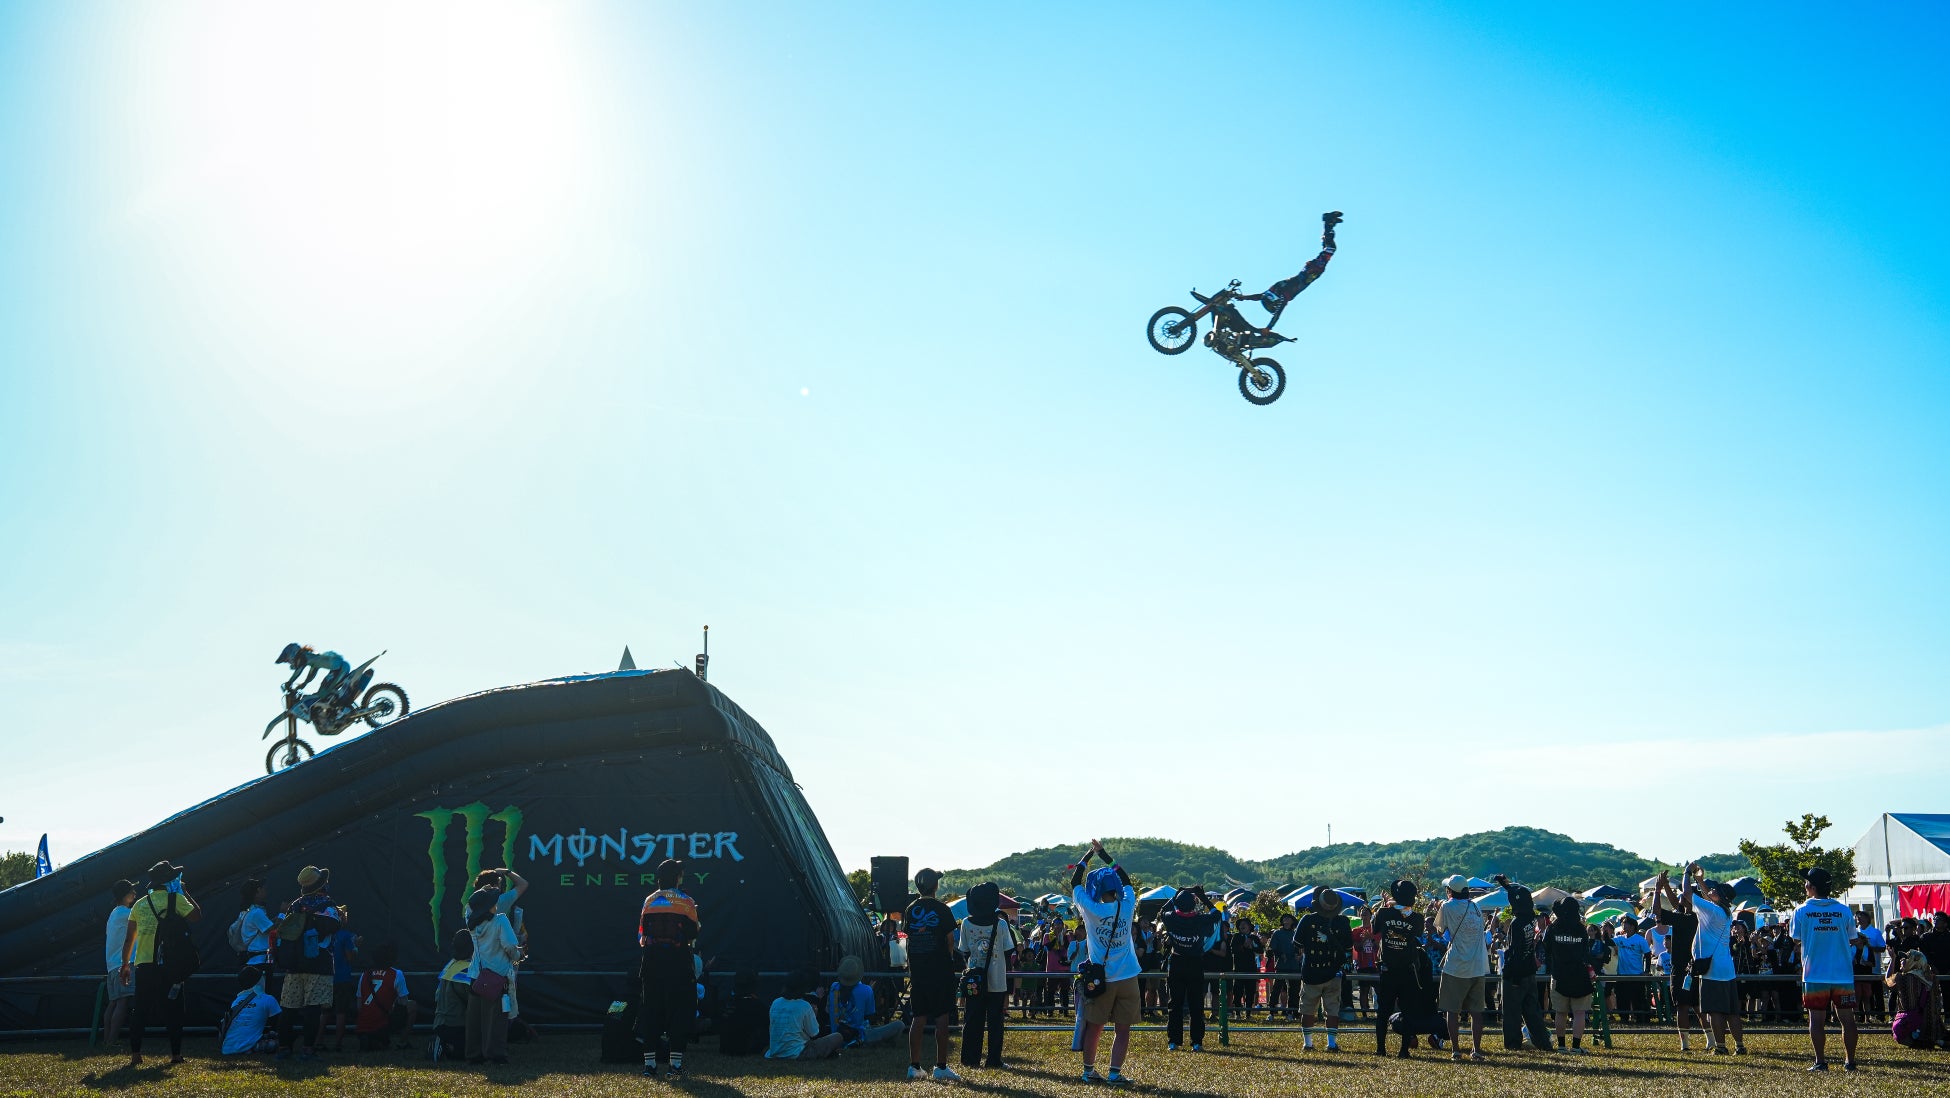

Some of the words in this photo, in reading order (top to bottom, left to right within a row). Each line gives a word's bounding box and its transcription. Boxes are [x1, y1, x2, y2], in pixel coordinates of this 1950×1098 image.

[528, 827, 745, 867] MONSTER
[560, 872, 711, 886] ENERY
[1385, 919, 1413, 931] PROVE
[363, 979, 384, 1005] 7
